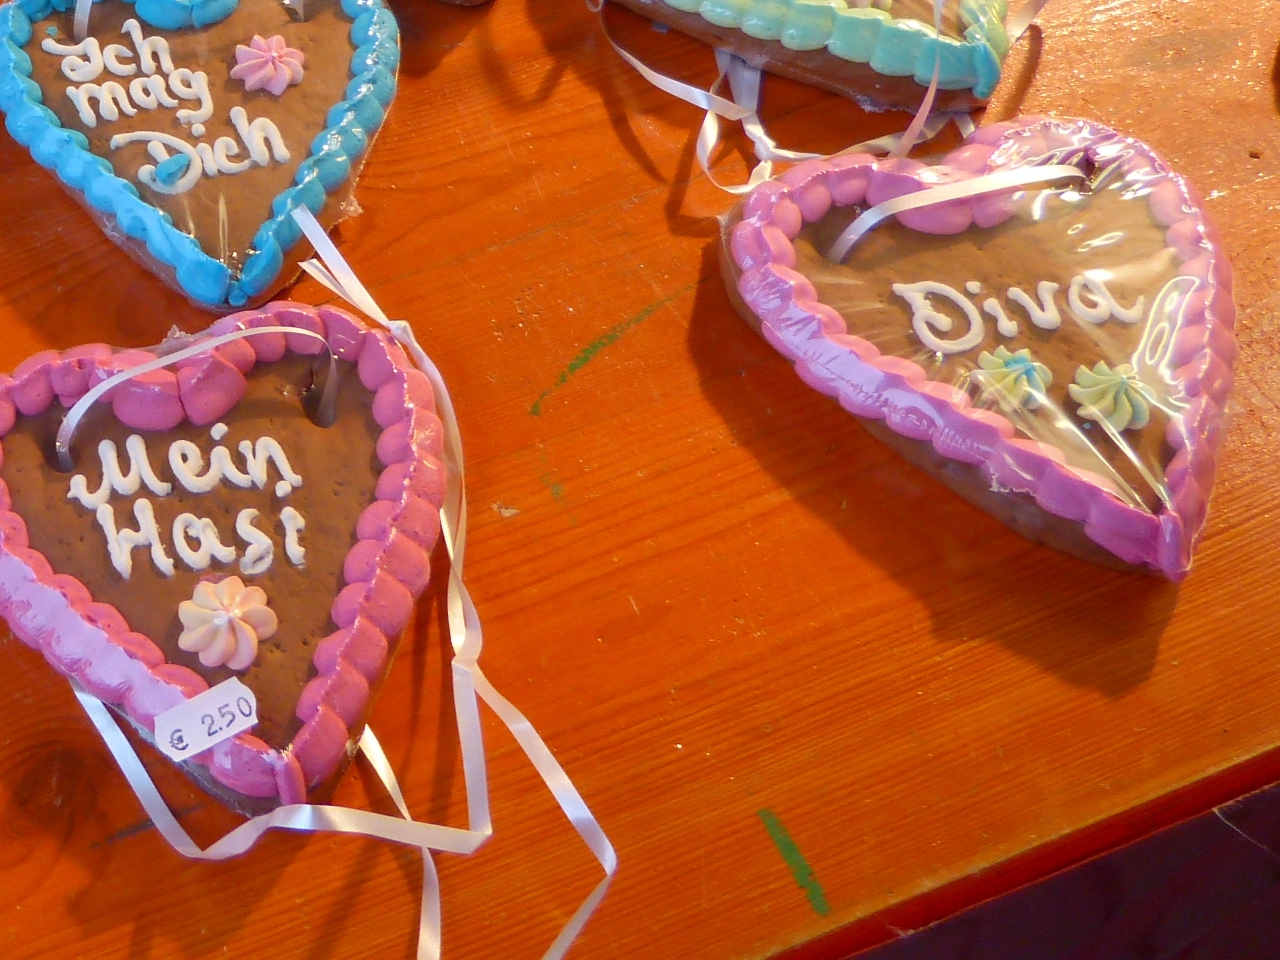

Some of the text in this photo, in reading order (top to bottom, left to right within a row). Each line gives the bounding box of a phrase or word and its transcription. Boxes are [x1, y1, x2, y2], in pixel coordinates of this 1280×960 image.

[40, 18, 176, 83] Ich
[66, 66, 215, 130] mag
[110, 106, 291, 196] Dich
[891, 273, 1145, 355] Diva
[66, 422, 303, 510] Mein
[96, 480, 307, 580] Hasi
[168, 695, 254, 752] € 2.50
